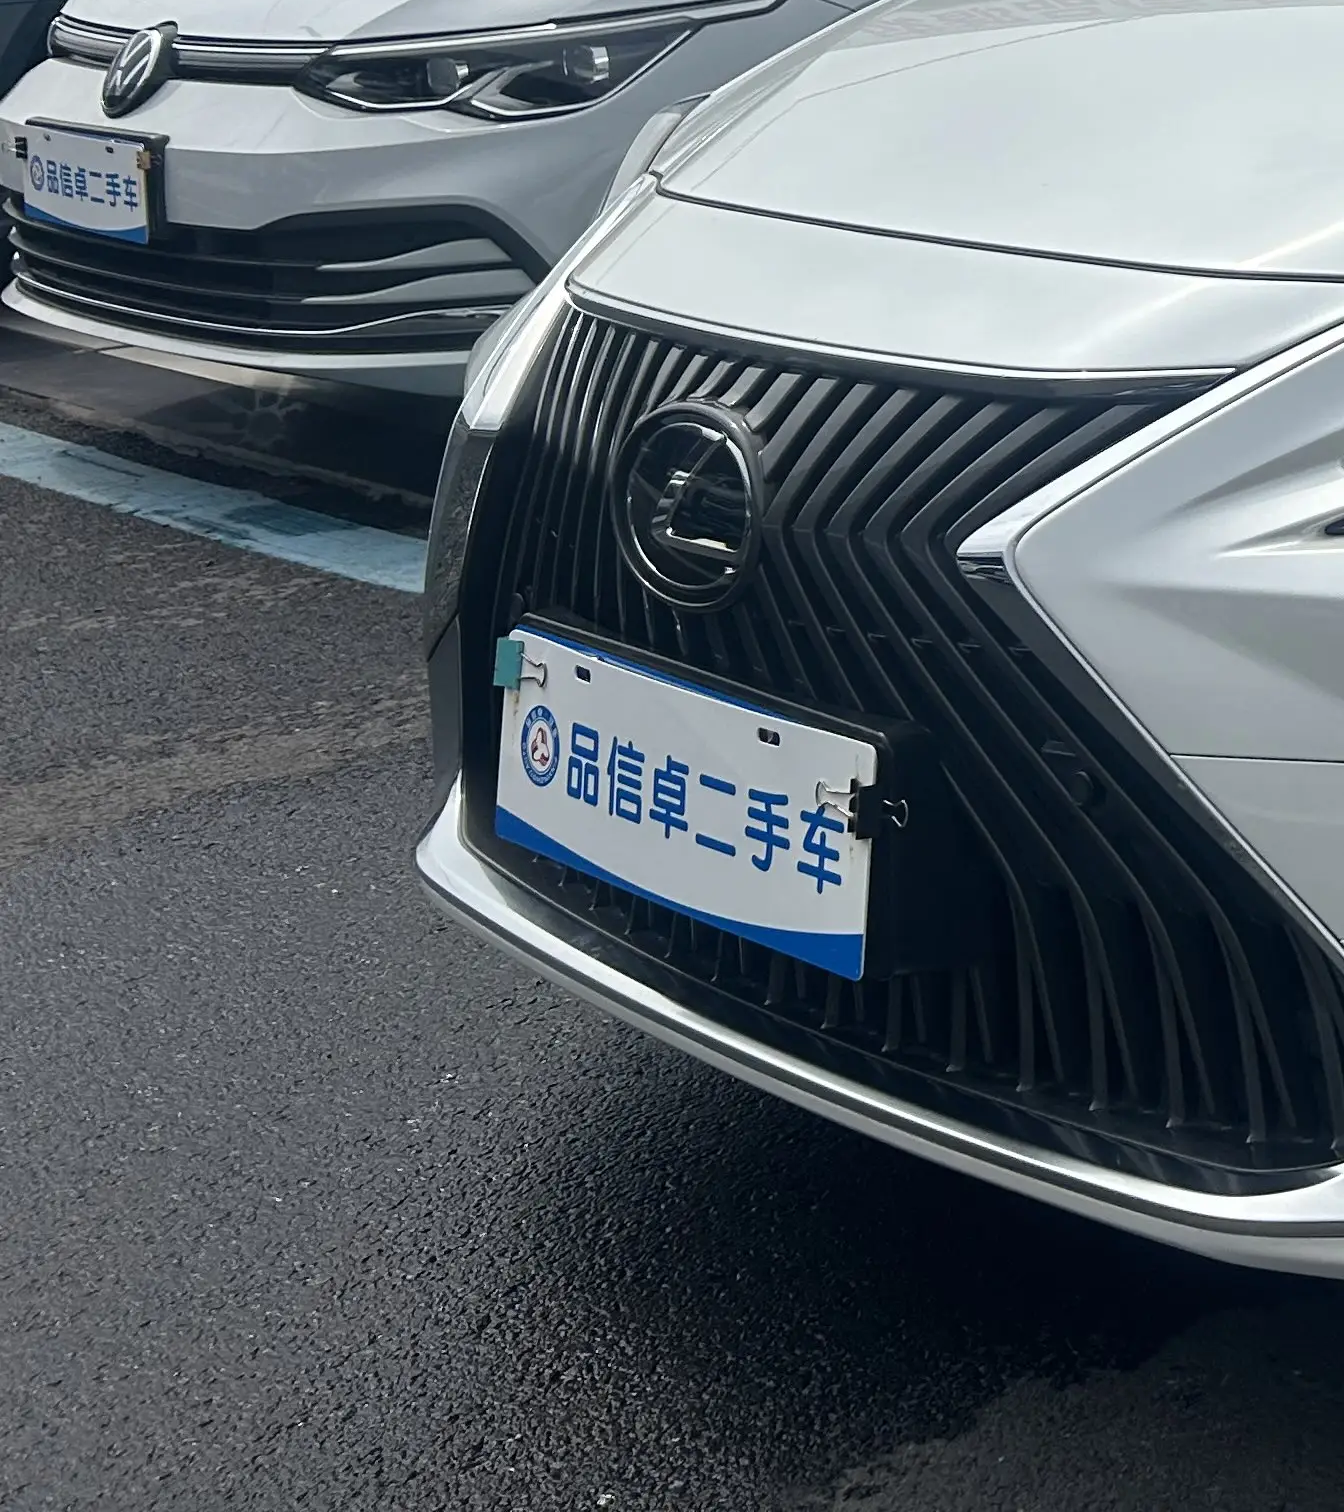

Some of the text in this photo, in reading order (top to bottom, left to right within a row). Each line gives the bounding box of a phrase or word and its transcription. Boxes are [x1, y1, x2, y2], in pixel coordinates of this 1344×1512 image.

[47, 159, 139, 213] 品信卓二手车
[566, 721, 845, 894] 品信卓二手车
